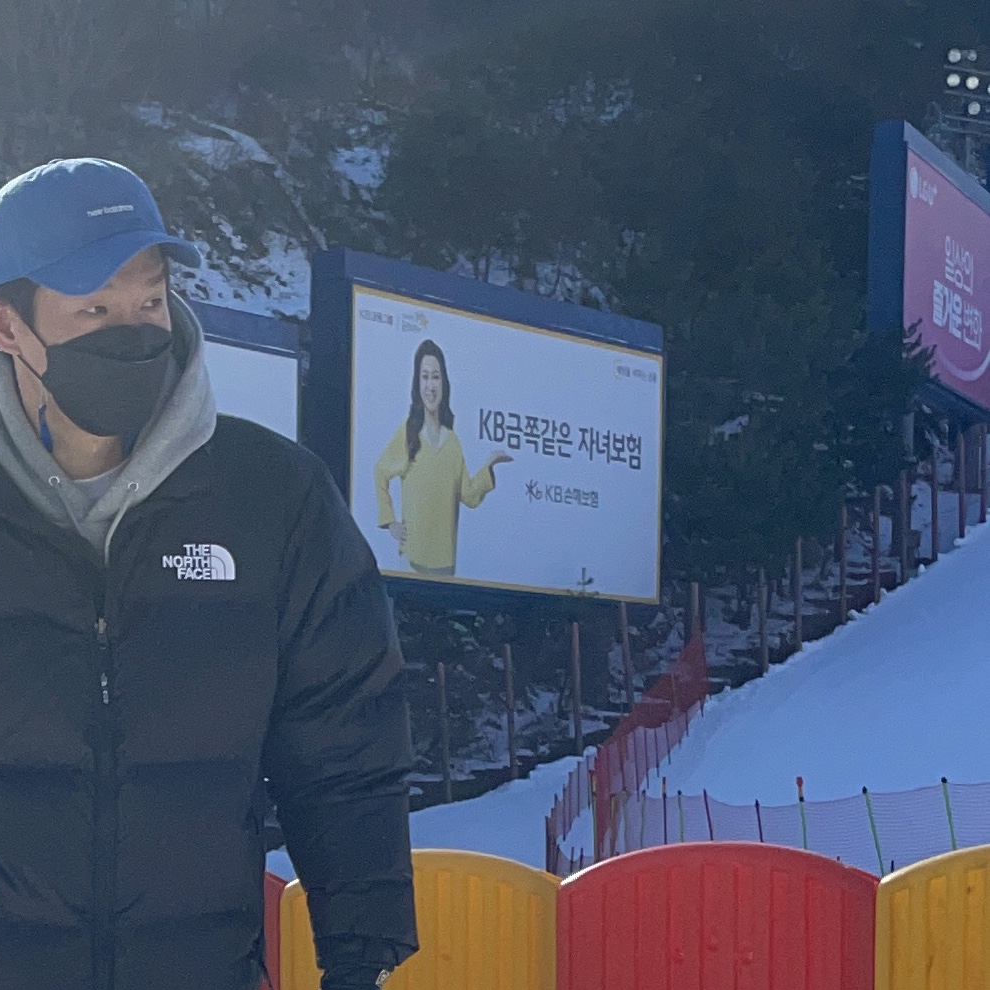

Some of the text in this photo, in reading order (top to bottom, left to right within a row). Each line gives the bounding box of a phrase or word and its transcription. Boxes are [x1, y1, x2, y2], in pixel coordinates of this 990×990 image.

[479, 408, 642, 470] KB금쪽같은 자녀보험
[183, 543, 211, 556] THE
[162, 555, 211, 568] NORTH
[177, 567, 211, 580] FACE
